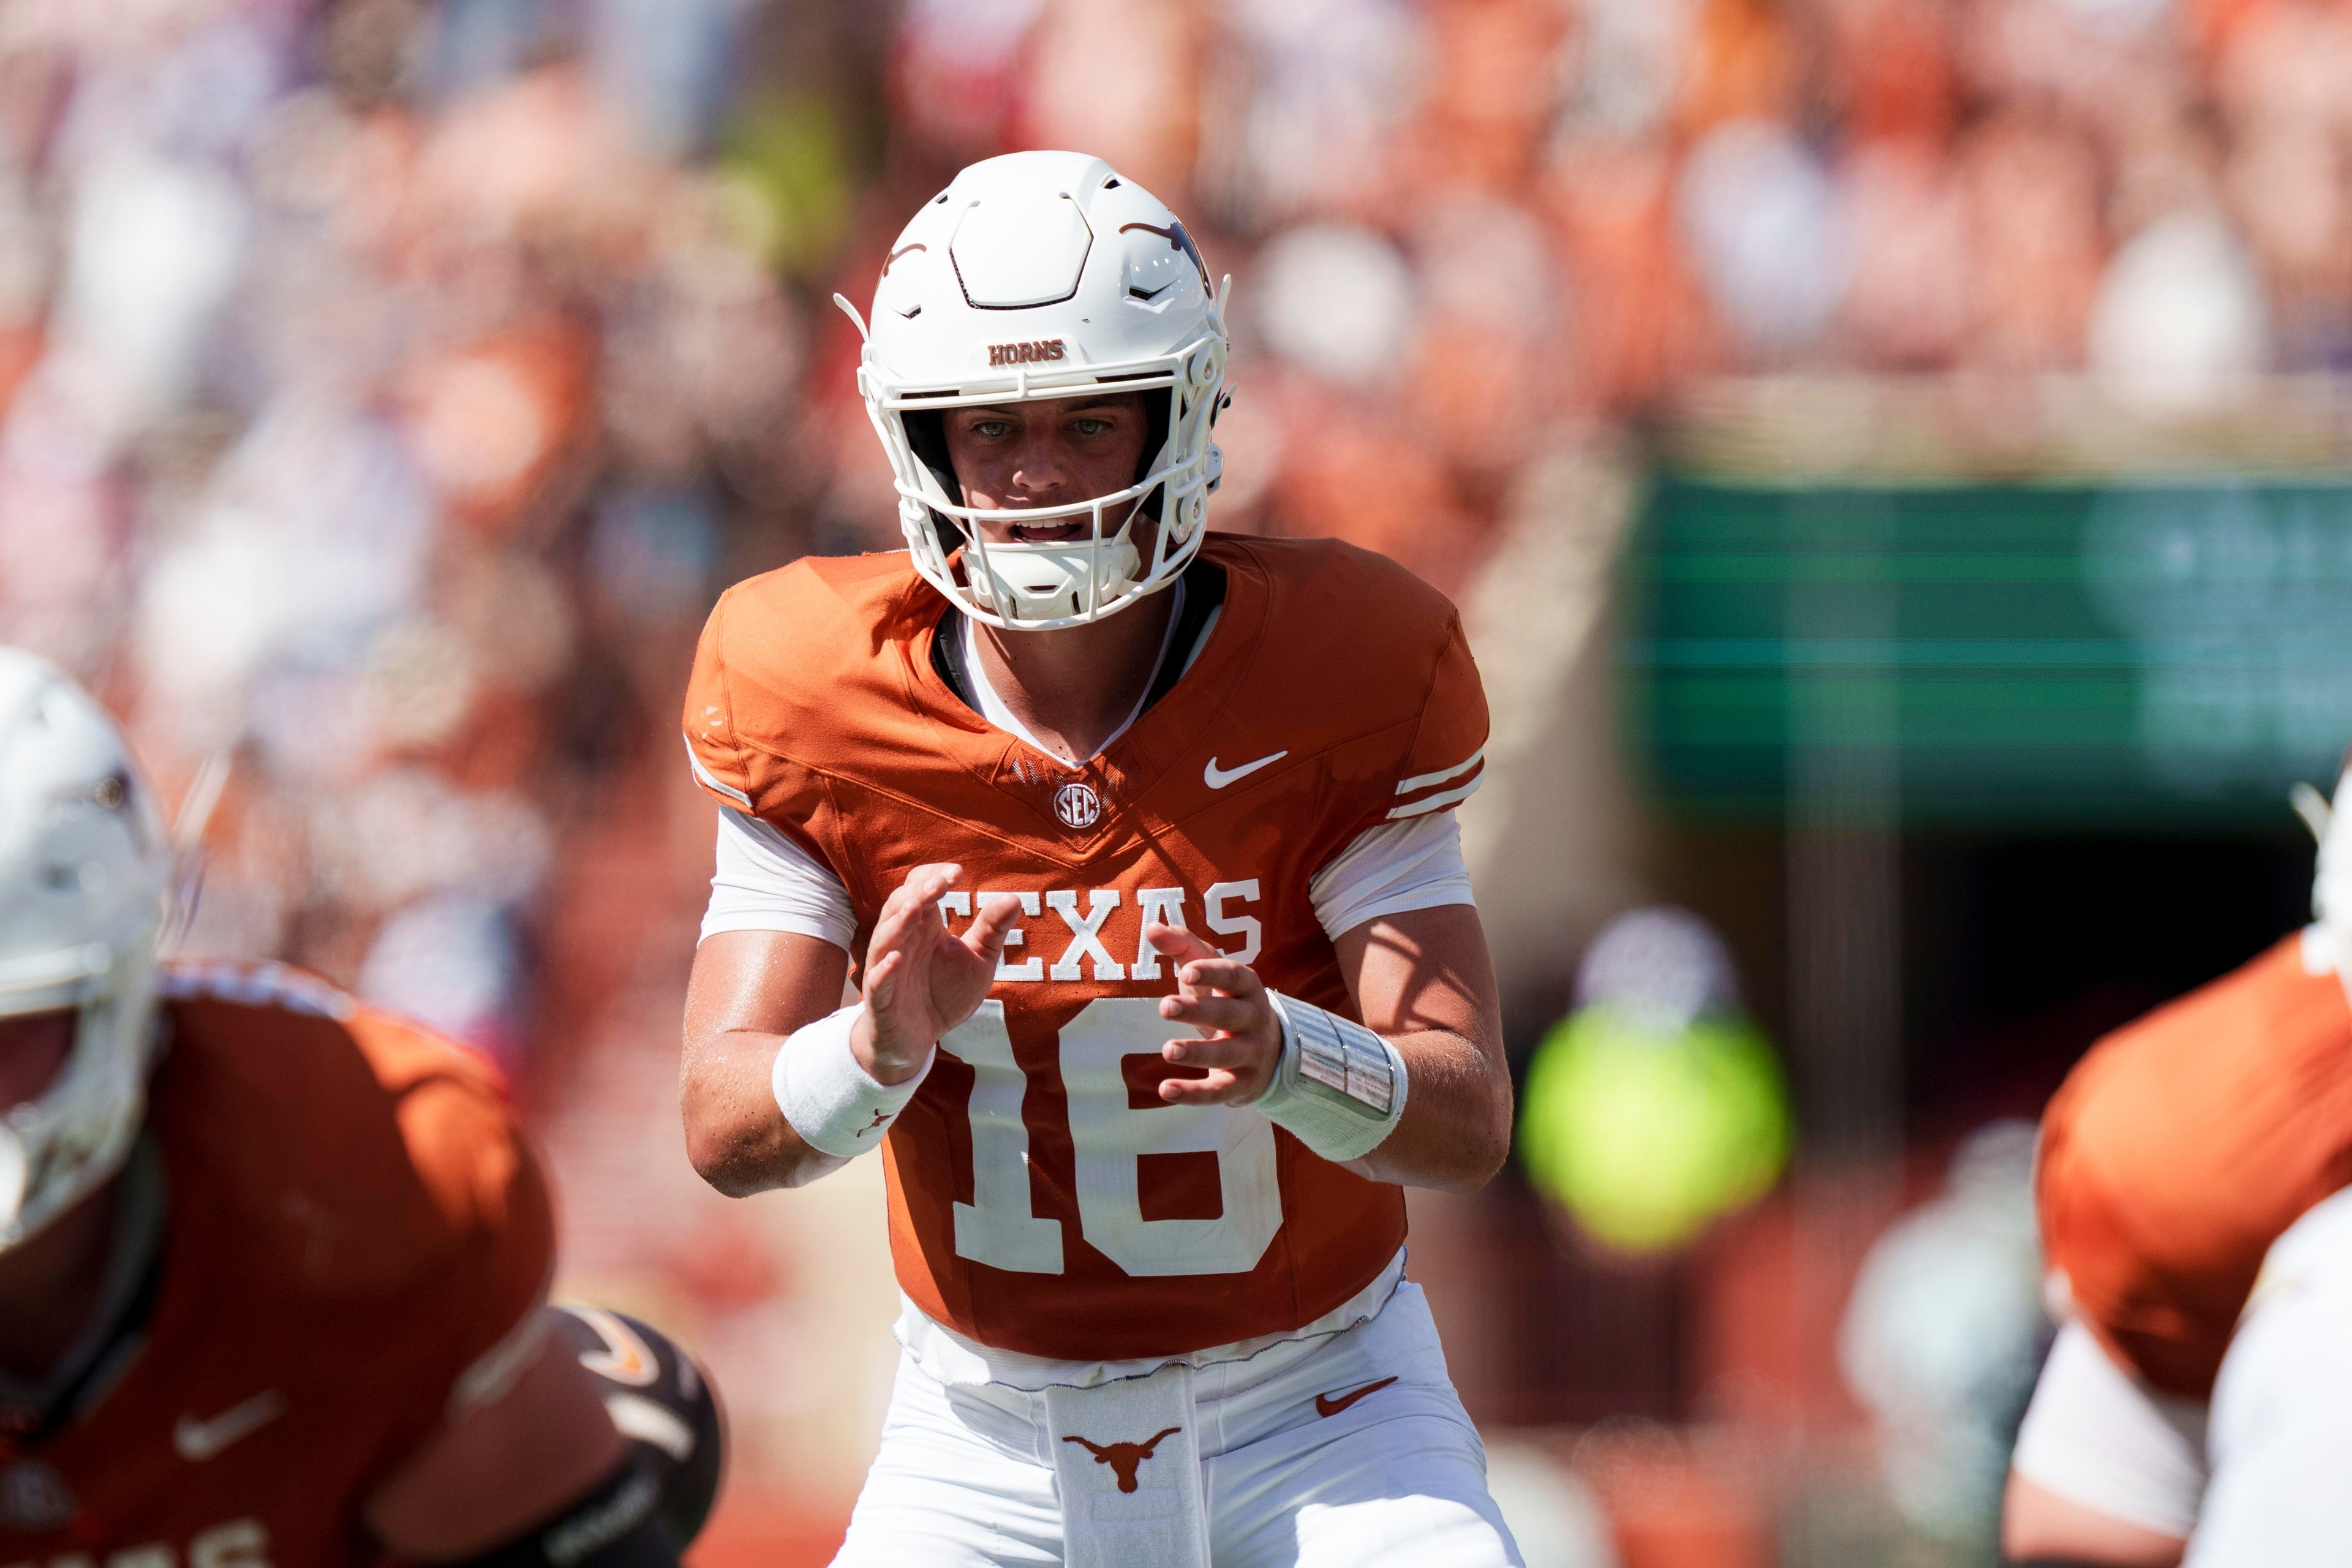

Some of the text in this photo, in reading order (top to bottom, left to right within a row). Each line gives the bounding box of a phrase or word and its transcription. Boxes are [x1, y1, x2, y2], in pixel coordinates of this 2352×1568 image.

[987, 339, 1064, 366] HORNS
[1058, 788, 1096, 826] SEC
[940, 997, 1284, 1277] 16
